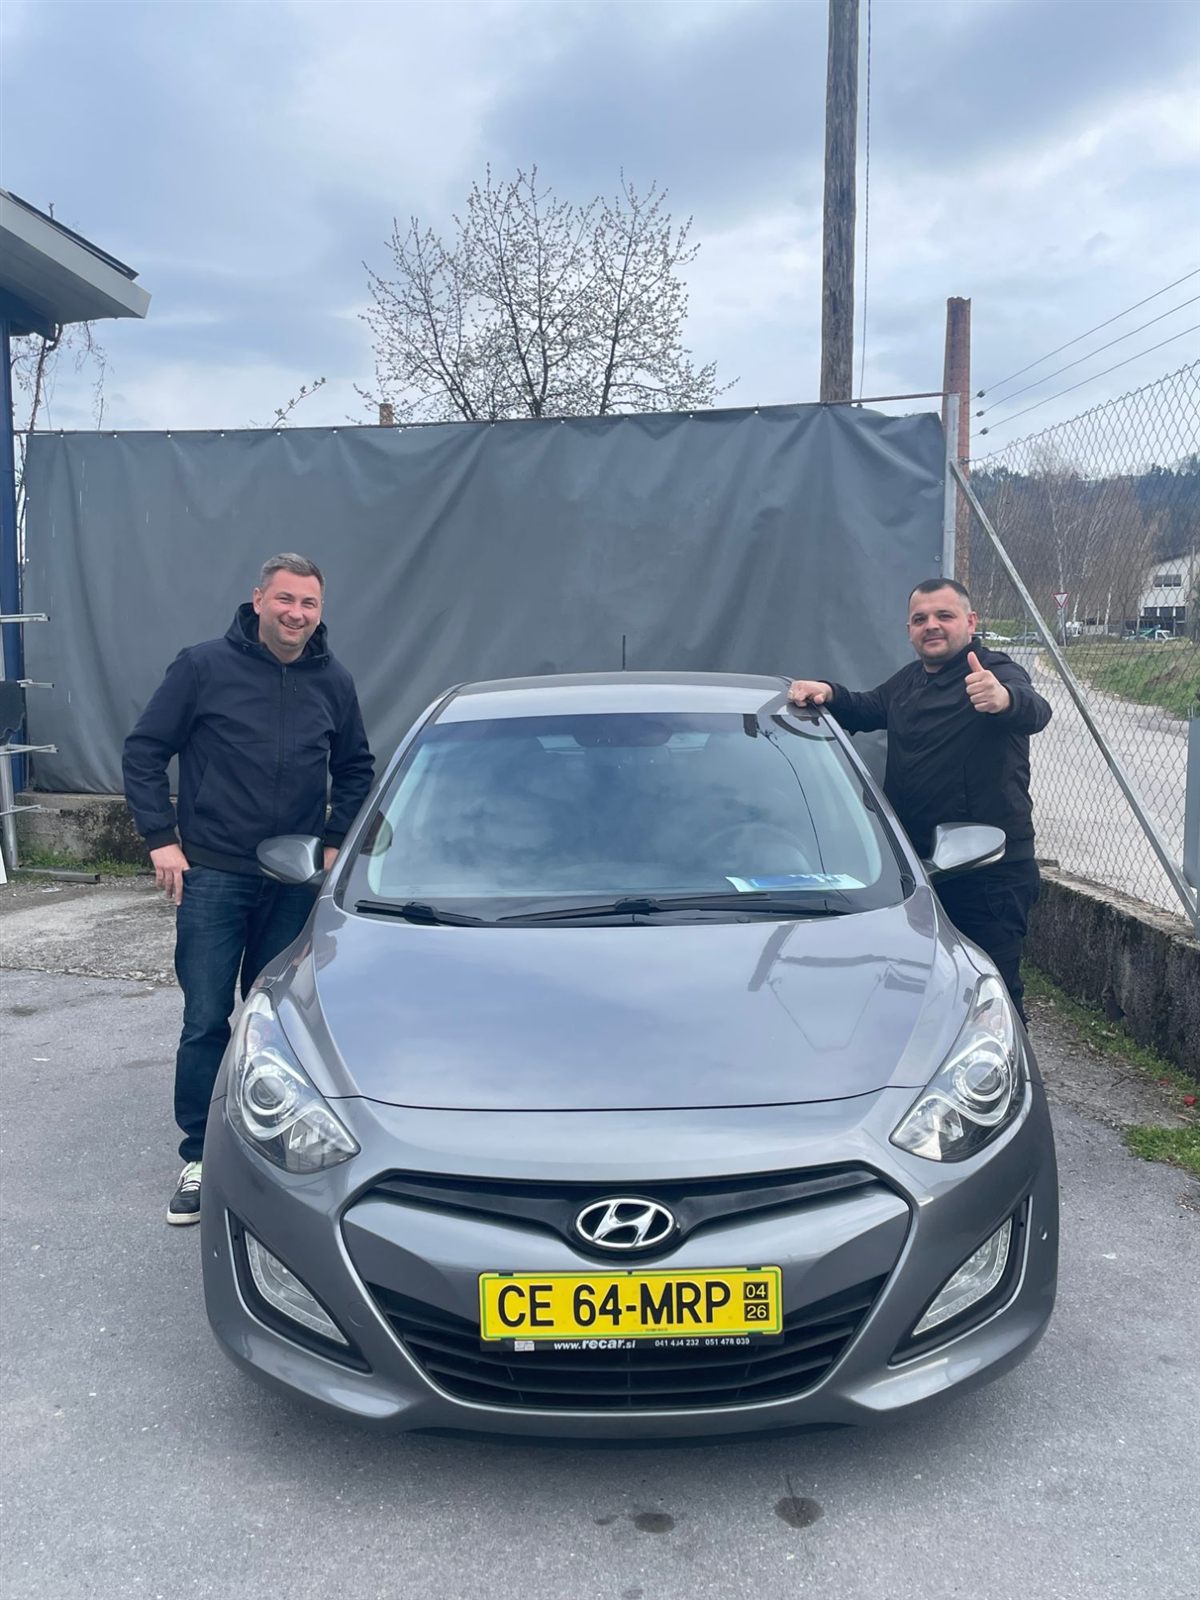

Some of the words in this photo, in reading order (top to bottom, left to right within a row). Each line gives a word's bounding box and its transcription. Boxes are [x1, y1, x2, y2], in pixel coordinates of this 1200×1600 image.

[746, 1284, 766, 1298] 04
[498, 1284, 554, 1327] CE
[573, 1281, 731, 1327] 64-MRP
[747, 1305, 767, 1319] 26
[554, 1339, 636, 1351] www.recar.si
